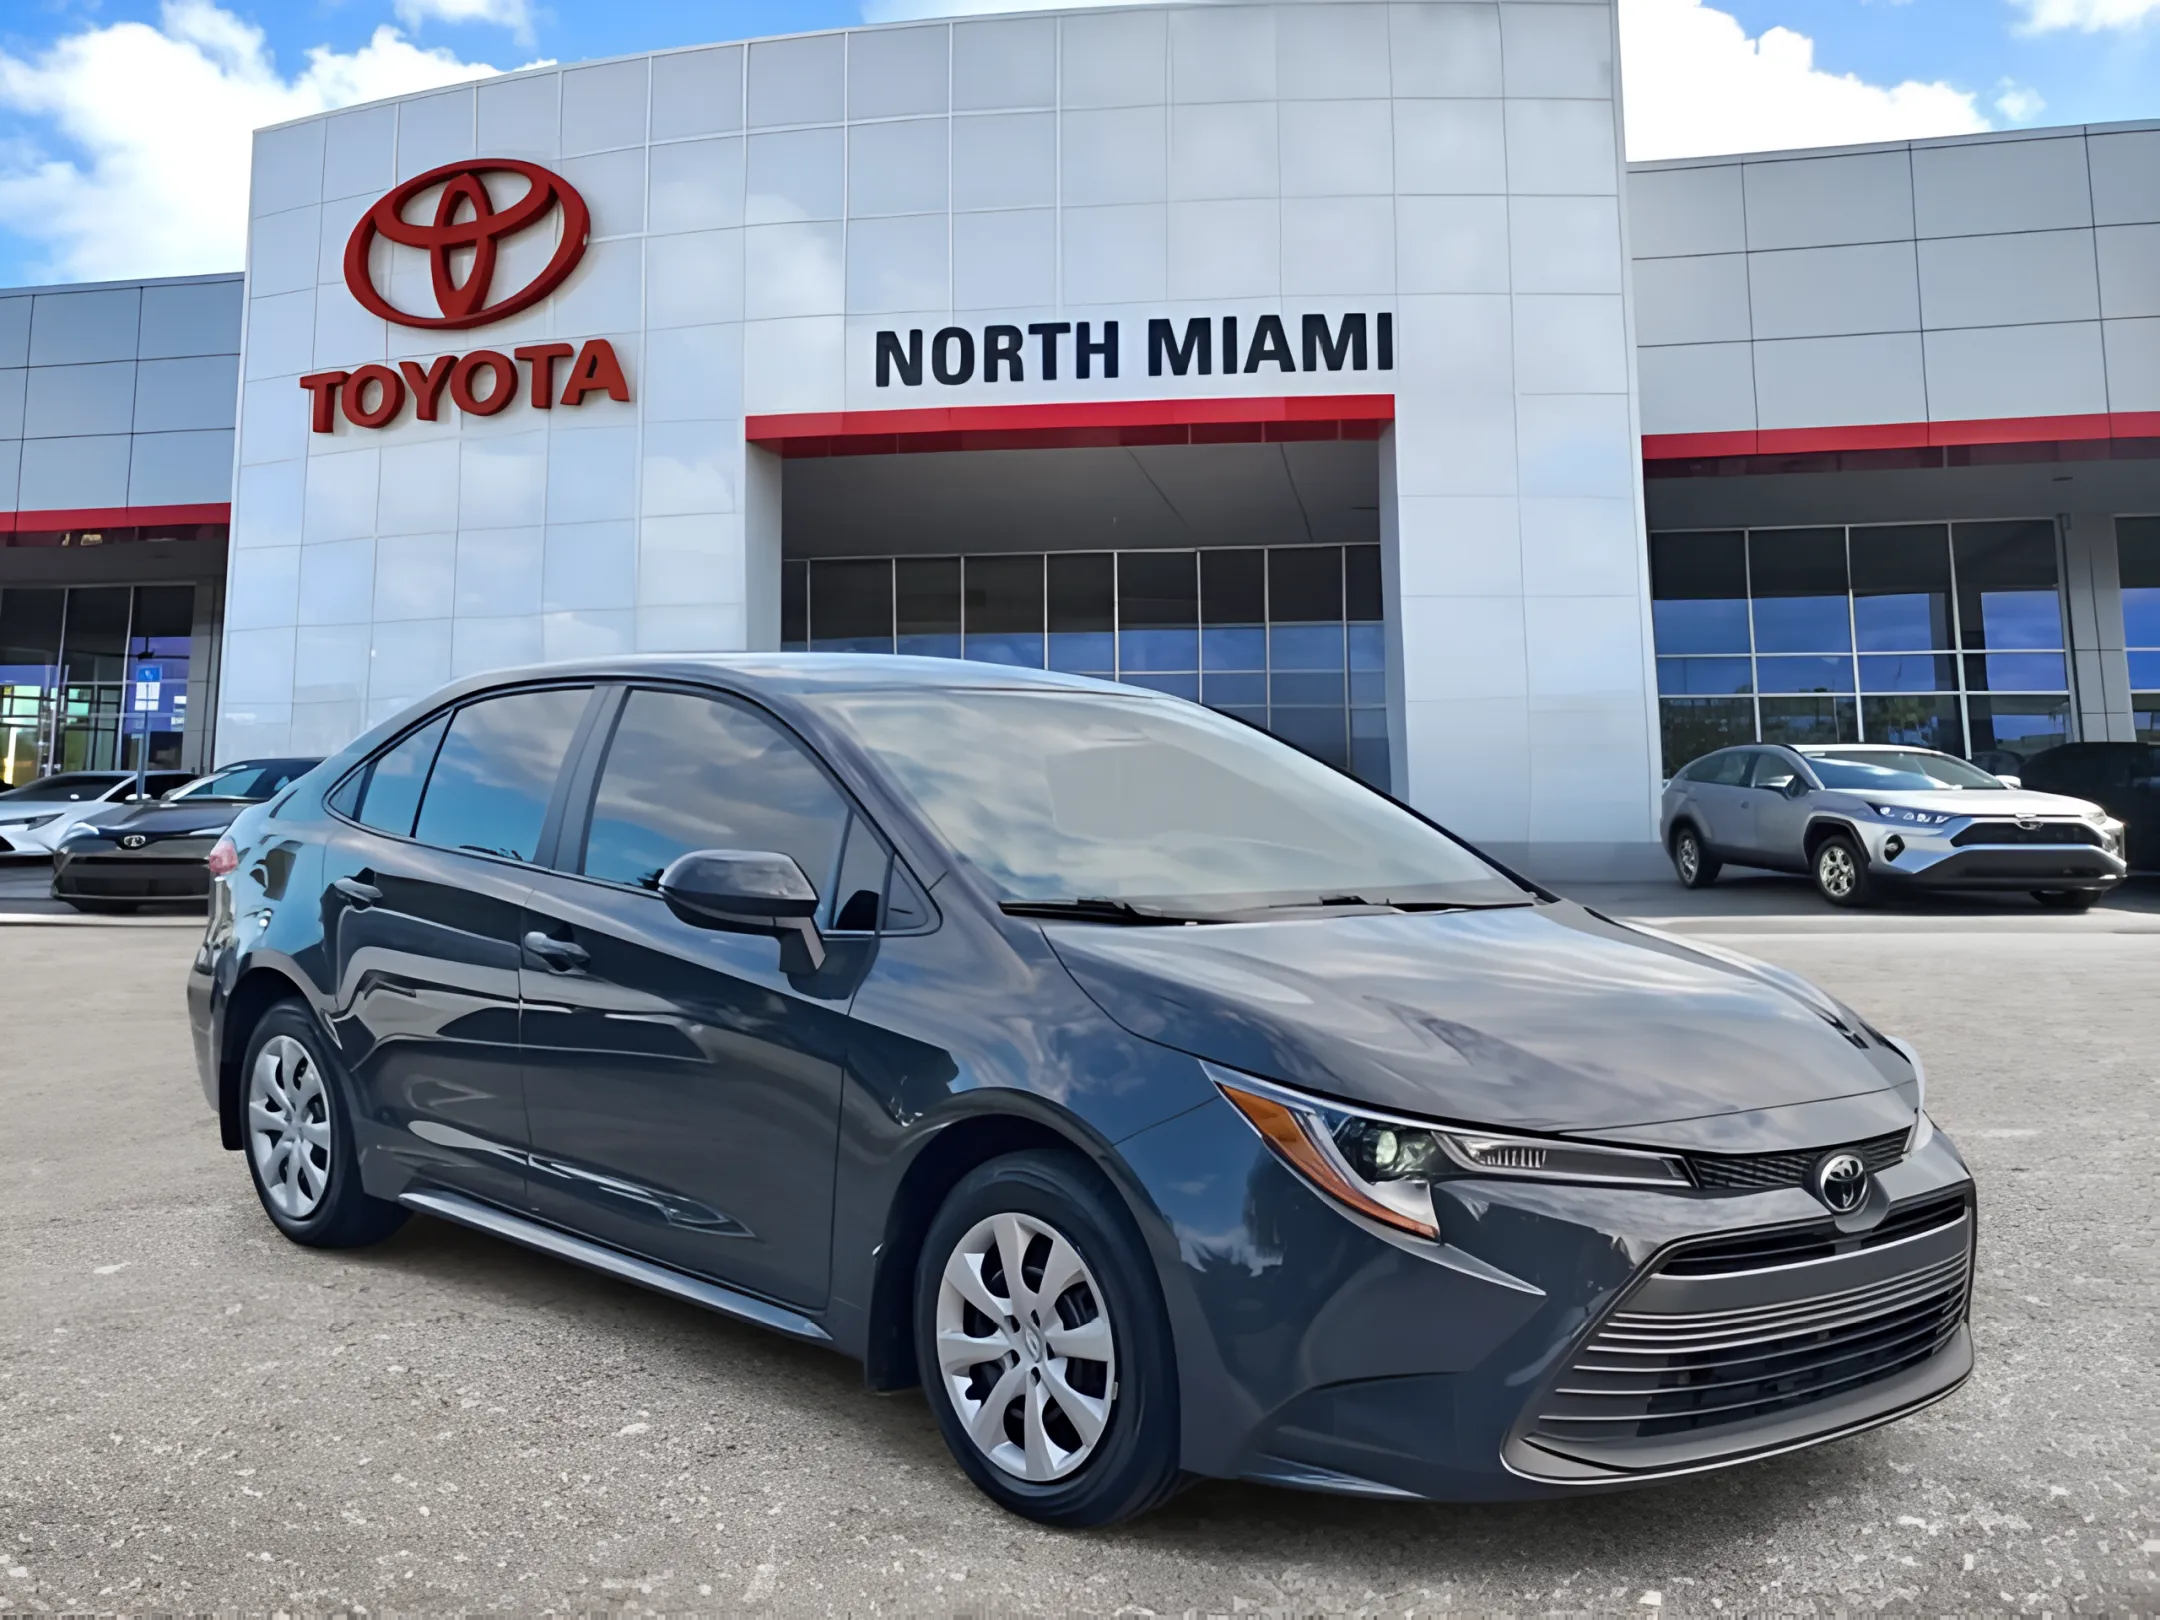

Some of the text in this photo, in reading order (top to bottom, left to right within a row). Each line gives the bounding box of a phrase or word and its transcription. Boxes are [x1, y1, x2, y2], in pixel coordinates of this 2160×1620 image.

[300, 339, 630, 433] TOYOTA
[875, 312, 1394, 388] NORTH MIAMI
